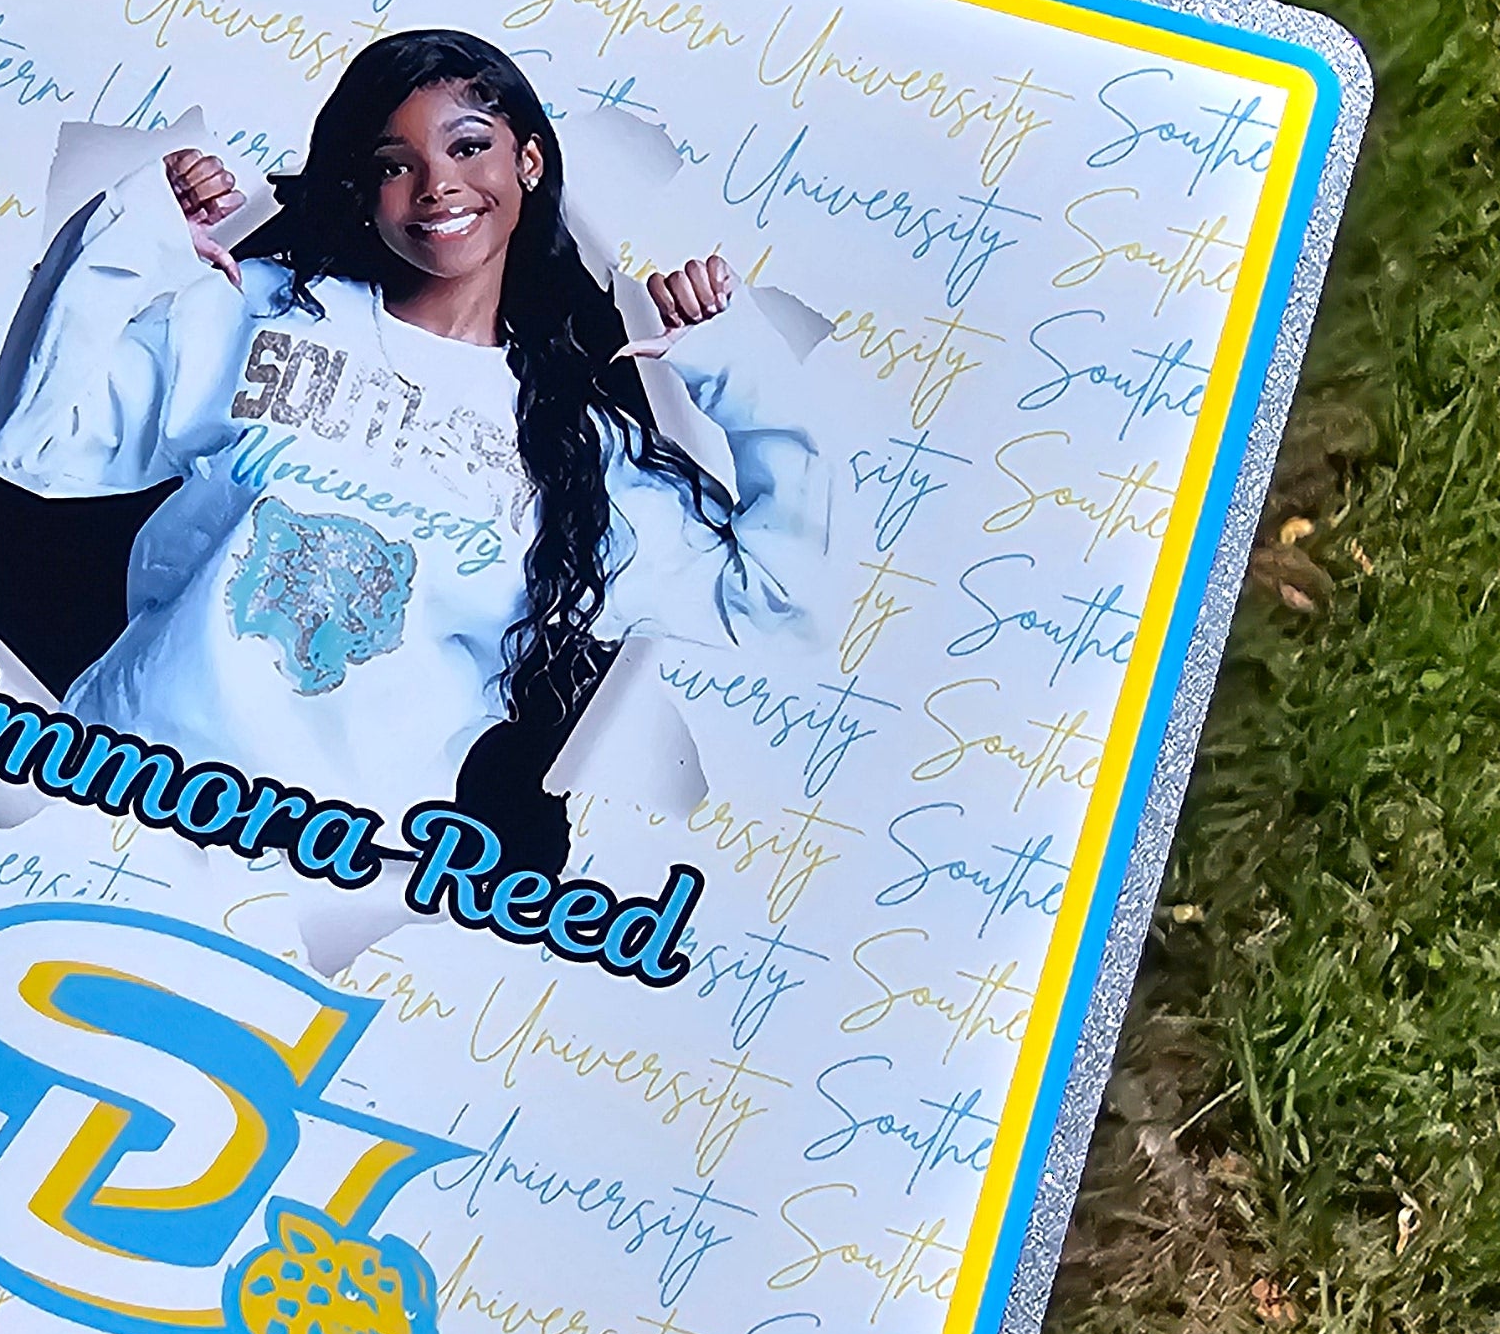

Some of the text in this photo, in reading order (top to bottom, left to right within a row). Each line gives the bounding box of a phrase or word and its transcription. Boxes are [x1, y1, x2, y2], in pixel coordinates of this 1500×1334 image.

[758, 5, 1075, 187] University
[724, 123, 1042, 306] University
[227, 424, 506, 577] University
[401, 800, 706, 988] Reed
[470, 980, 793, 1176] University
